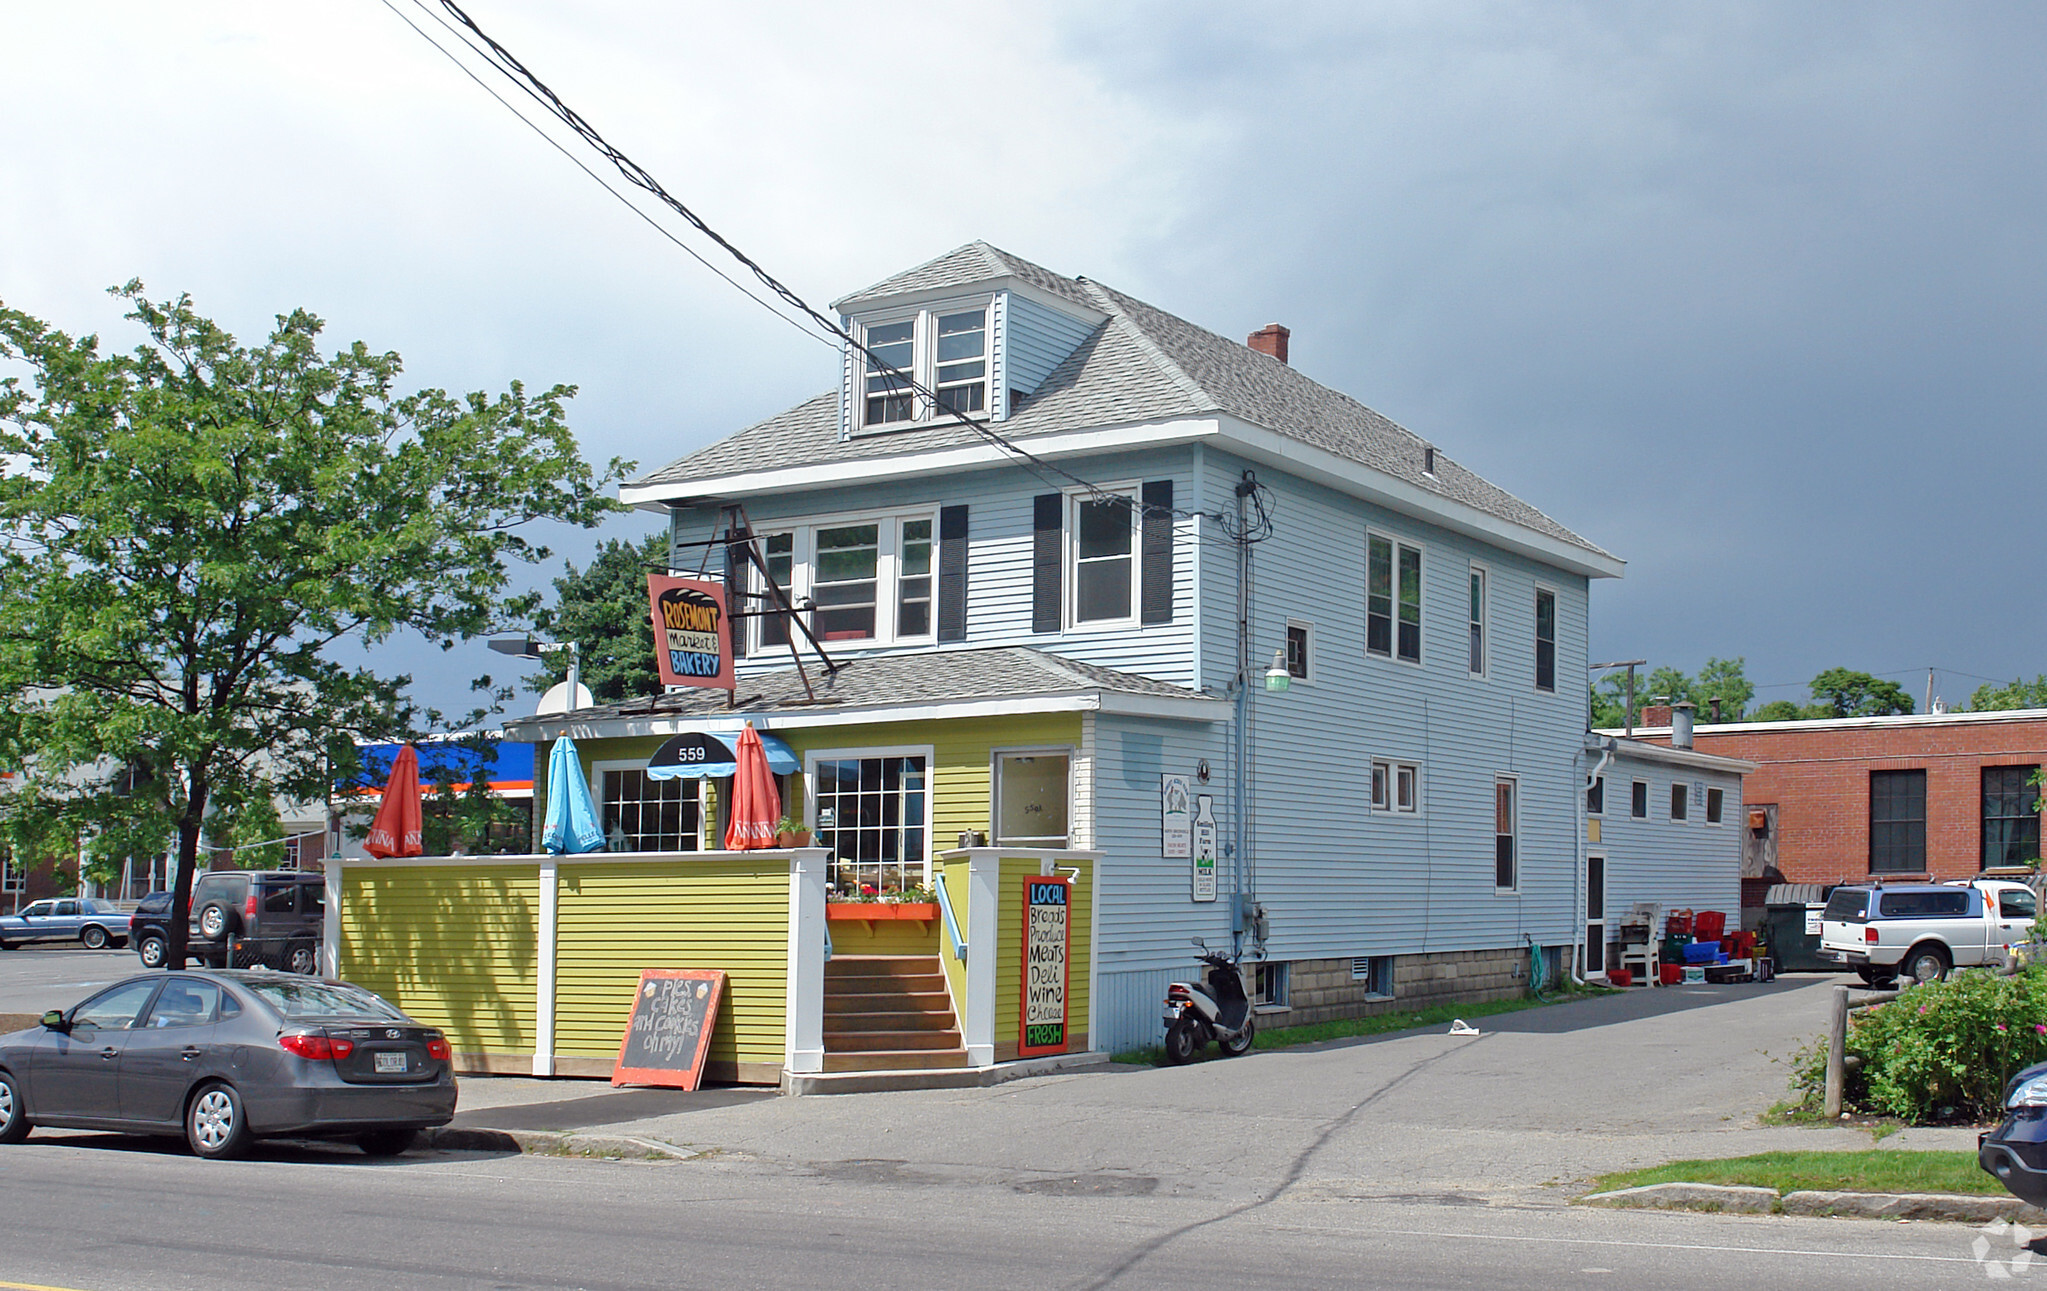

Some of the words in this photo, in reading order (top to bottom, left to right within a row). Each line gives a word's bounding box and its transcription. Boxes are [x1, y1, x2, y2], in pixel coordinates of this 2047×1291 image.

[662, 600, 718, 632] ROSEMONT
[670, 650, 719, 674] BAKERY
[678, 746, 706, 762] 559
[1031, 884, 1066, 904] LOCAL
[1031, 907, 1065, 924] Breads
[1030, 926, 1065, 944] Produce
[1031, 966, 1060, 985] Deli
